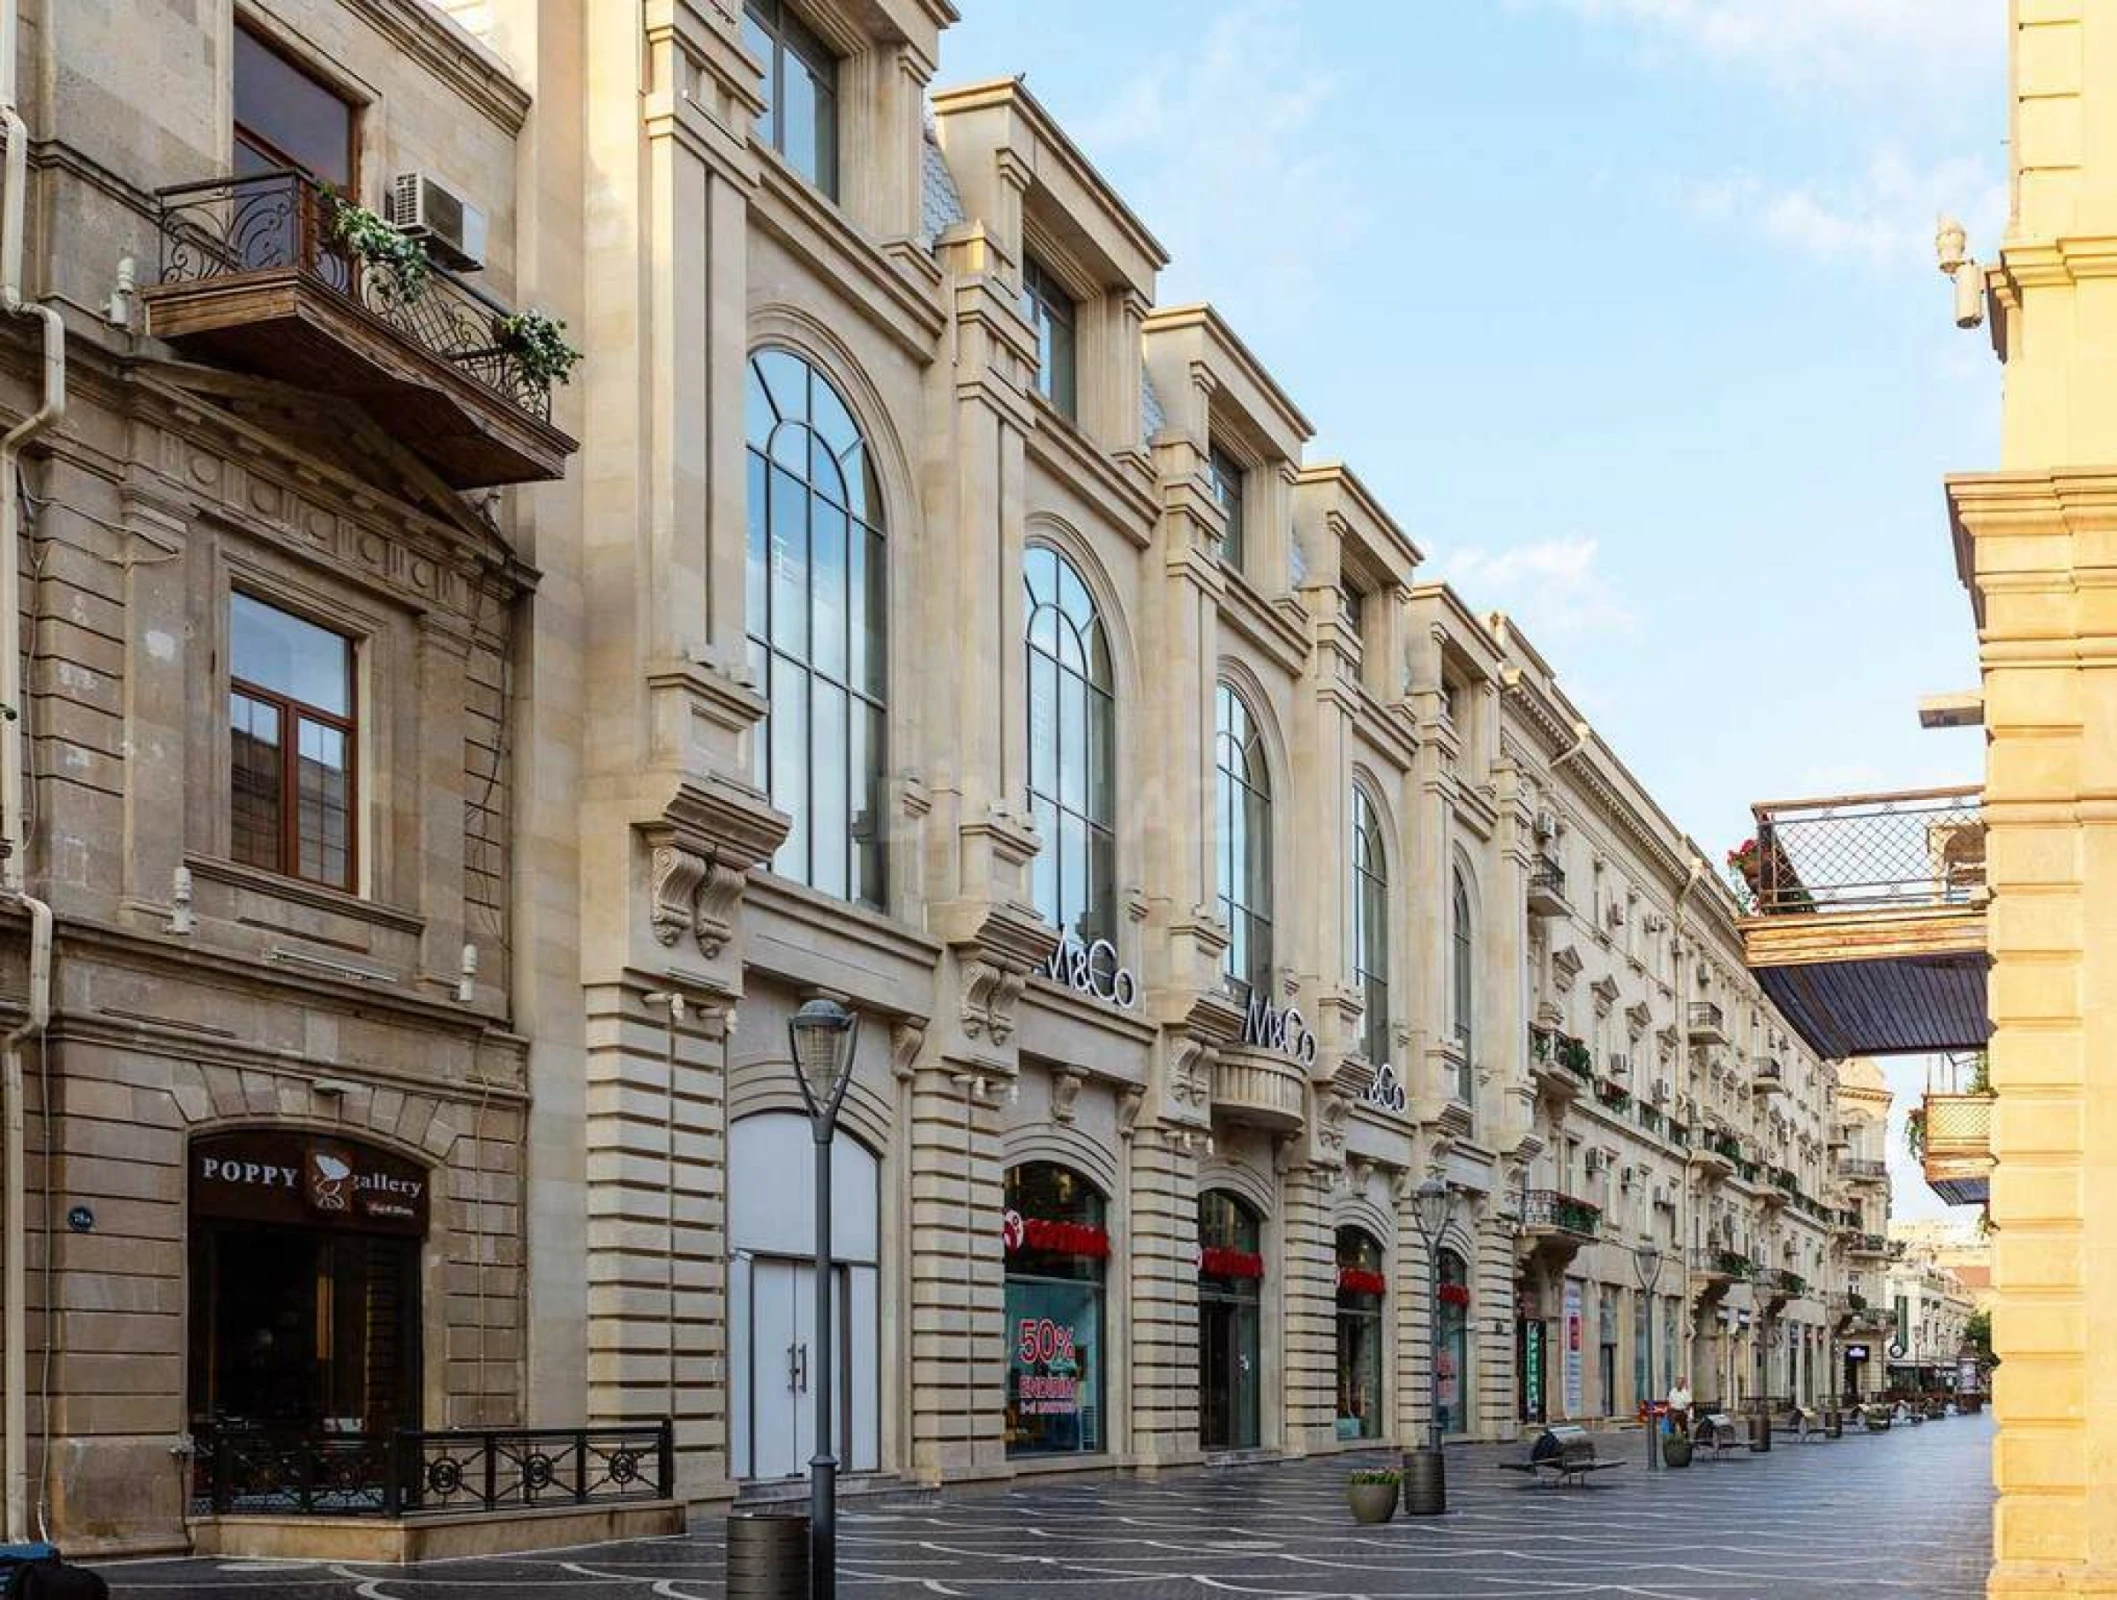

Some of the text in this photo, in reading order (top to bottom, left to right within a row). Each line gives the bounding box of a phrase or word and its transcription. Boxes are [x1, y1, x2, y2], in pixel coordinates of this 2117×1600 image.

[1033, 923, 1136, 1009] M&Co
[1244, 986, 1317, 1067] M&Co
[203, 1157, 298, 1188] POPPY
[1019, 1318, 1076, 1363] 50%
